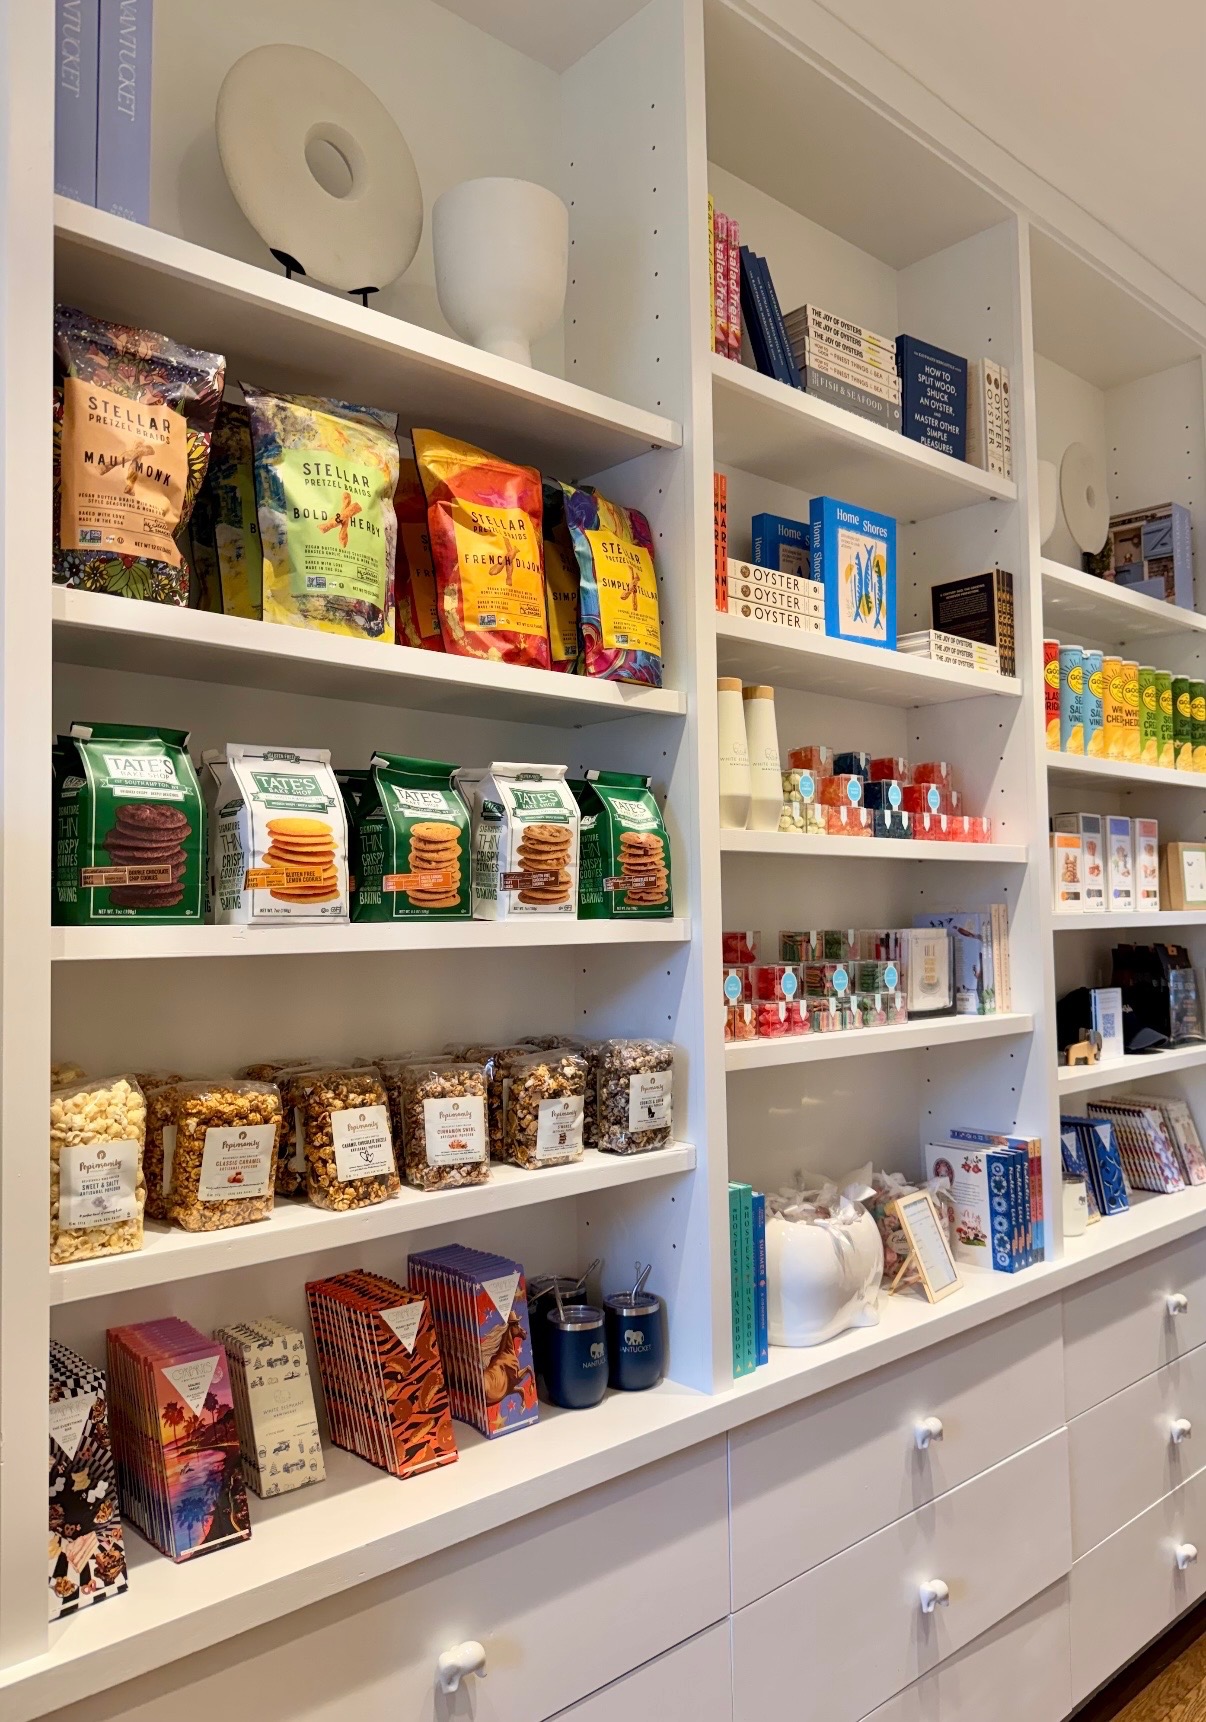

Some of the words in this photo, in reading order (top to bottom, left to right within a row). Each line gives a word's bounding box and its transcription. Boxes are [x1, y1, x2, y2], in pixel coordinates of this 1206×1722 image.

[729, 250, 740, 294] salad
[730, 292, 742, 334] freak
[812, 308, 822, 318] THE
[822, 312, 832, 322] JOY
[833, 316, 840, 324] OF
[841, 320, 862, 336] OYSTERS
[812, 318, 822, 329] THE
[823, 323, 832, 333] JOY
[834, 328, 840, 336] OF
[840, 331, 862, 346] OYSTERS
[814, 330, 824, 340] THE
[824, 336, 834, 345] JOY
[835, 340, 842, 349] OF
[842, 343, 864, 358] OYSTERS
[834, 354, 850, 365] FINEST
[851, 360, 868, 374] THINGS
[874, 371, 883, 380] SEA
[924, 365, 941, 378] HOW
[942, 372, 950, 382] TO
[834, 368, 850, 379] FINEST
[851, 376, 868, 388] THINGS
[874, 385, 882, 393] SEA
[918, 374, 934, 386] SPLIT
[934, 380, 957, 396] WOOD,
[820, 377, 838, 393] FISH
[840, 386, 846, 395] &
[846, 388, 882, 411] SEAFOOD
[926, 388, 948, 402] SHUCK
[88, 396, 171, 434] STELLAR
[920, 397, 930, 406] AN
[931, 400, 955, 416] OYSTER,
[914, 413, 938, 428] MASTER
[940, 422, 960, 435] OTHER
[986, 389, 994, 445] OYSTER
[89, 413, 132, 433] PRETZEL
[137, 428, 170, 445] BRAIDS
[927, 428, 948, 442] SIMPLE
[920, 436, 953, 454] PLEASURES
[84, 450, 125, 468] MAUI
[134, 462, 171, 487] MONK
[303, 463, 370, 488] STELLAR
[305, 480, 342, 489] PRETZEL
[344, 485, 372, 498] BRAIDS
[294, 508, 328, 520] BOLD
[335, 513, 343, 524] &
[350, 517, 380, 538] HERBY
[472, 512, 526, 531] STELLAR
[836, 508, 860, 525] Home
[863, 520, 888, 538] Shores
[778, 524, 801, 540] Home
[814, 521, 822, 548] Home
[602, 542, 640, 564] STELLAR
[464, 554, 511, 566] FRENCH
[516, 558, 540, 574] DIJON
[814, 552, 822, 583] Shores
[602, 578, 630, 592] SIMPLY
[754, 568, 800, 591] OYSTER
[754, 587, 800, 610] OYSTER
[754, 607, 800, 628] OYSTER
[934, 644, 942, 652] THE
[956, 649, 974, 658] OYSTERS
[956, 638, 972, 648] OYSTERS
[958, 660, 974, 669] OYSTERS
[108, 758, 173, 775] TATE'S
[256, 776, 316, 790] TATE'S
[395, 788, 442, 803] TATE'S
[514, 791, 558, 803] TATE'S
[613, 800, 646, 814] TATE'S
[58, 817, 78, 837] THIN
[218, 821, 240, 832] SIGNATURE
[480, 825, 502, 833] SIGNATURE
[220, 832, 242, 853] THIN
[360, 835, 383, 852] THIN
[480, 834, 500, 850] THIN
[222, 852, 245, 868] CRISPY
[362, 852, 384, 866] CRISPY
[476, 850, 500, 862] CRISPY
[580, 858, 602, 870] CRISPY
[220, 866, 244, 879] COOKIES
[476, 862, 499, 872] COOKIES
[220, 895, 242, 910] BAKING
[360, 892, 382, 904] BAKING
[476, 888, 497, 900] BAKING
[439, 1110, 472, 1122] Popinsanity
[222, 1140, 260, 1152] Popinsanity
[80, 1159, 122, 1174] Popinsanity
[263, 1406, 278, 1414] WHITE
[281, 1401, 304, 1410] ELEPHANT
